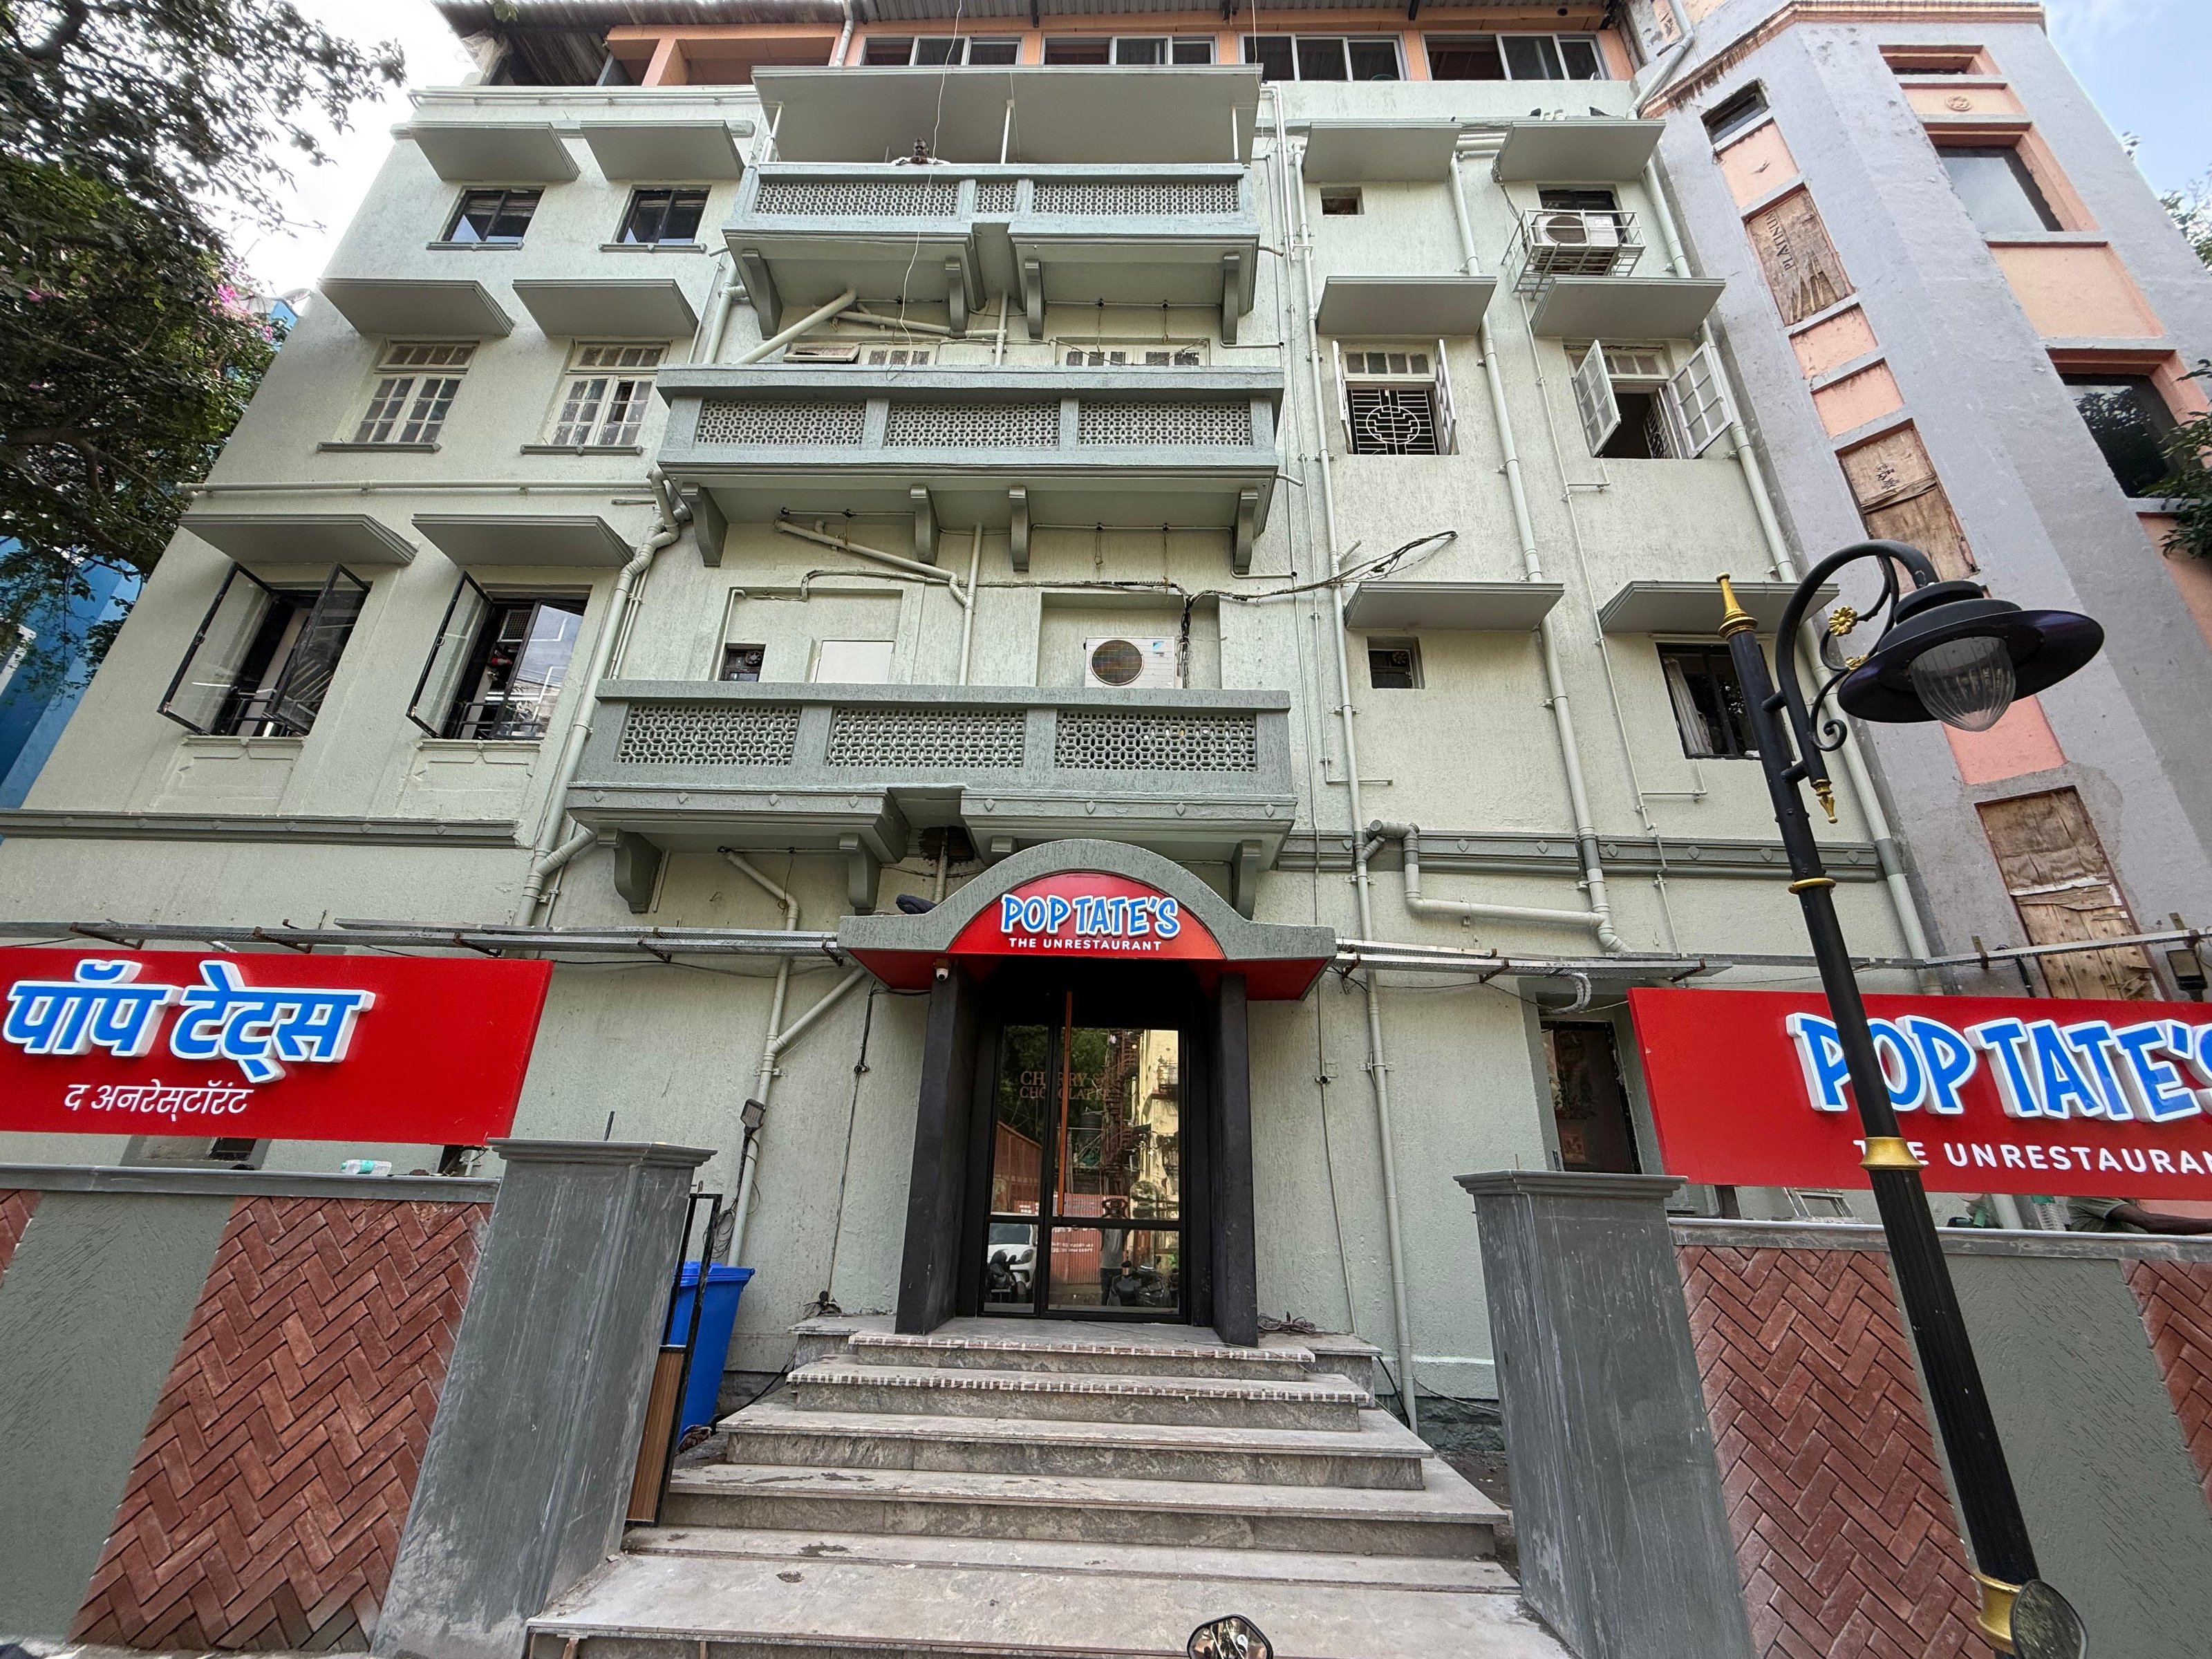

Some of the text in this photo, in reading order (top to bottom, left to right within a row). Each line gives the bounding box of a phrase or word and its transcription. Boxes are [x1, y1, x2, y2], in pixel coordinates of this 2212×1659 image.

[1765, 209, 1795, 272] PLATINUM
[1001, 894, 1181, 939] POP TATE'S
[1009, 937, 1162, 951] THE UNRESTAURANT
[3, 959, 373, 1084] पॉप टेट्स
[1020, 1071, 1087, 1087] CHRY
[1786, 1012, 2212, 1123] POP TATE'
[64, 1084, 91, 1111] द
[1853, 1140, 1929, 1165] TE
